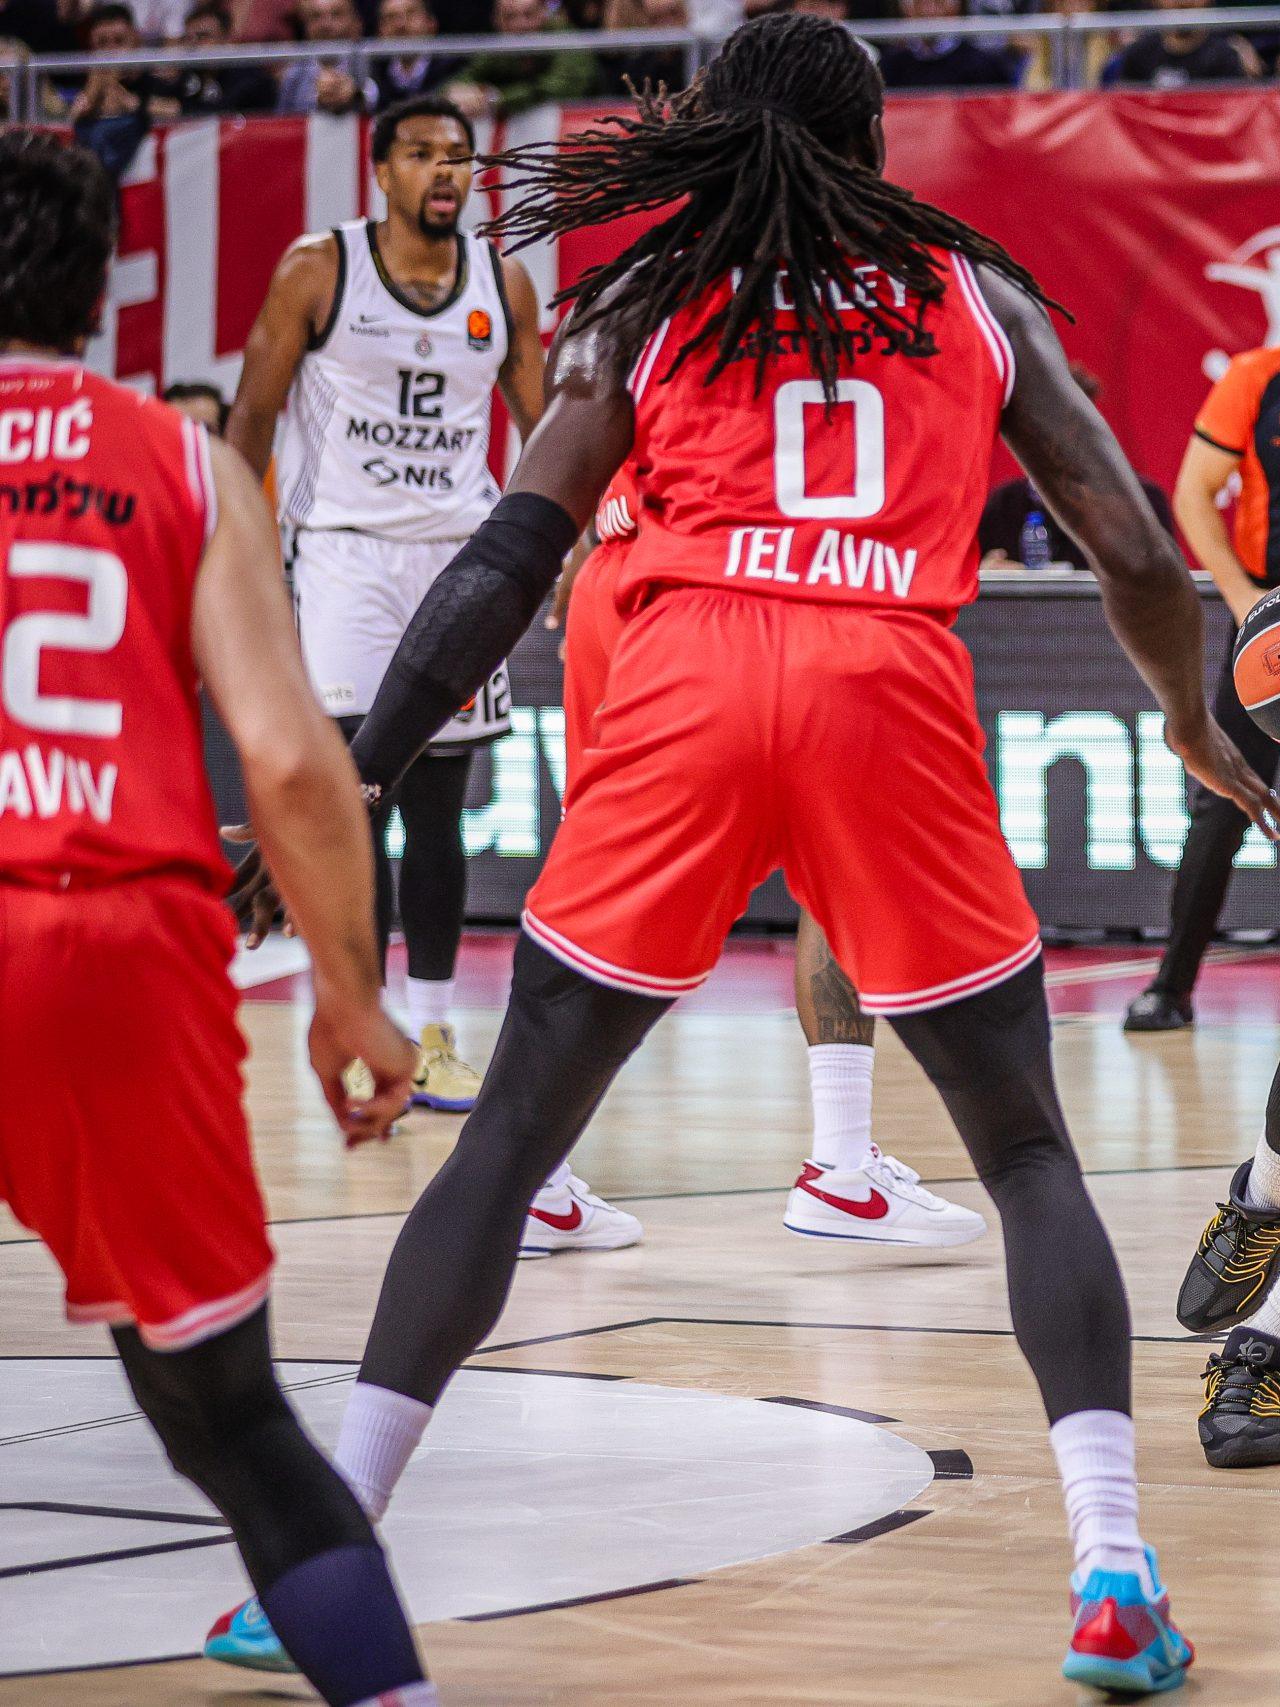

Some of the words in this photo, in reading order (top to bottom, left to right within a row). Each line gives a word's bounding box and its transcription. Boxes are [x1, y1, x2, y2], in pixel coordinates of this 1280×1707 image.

[398, 370, 446, 419] 12
[0, 396, 94, 465] CIĆ
[346, 417, 477, 451] MOZZART
[774, 379, 887, 520] 0
[405, 464, 455, 490] NIS
[724, 526, 800, 583] TEL
[805, 527, 918, 599] AVIV
[5, 541, 129, 739] 2
[0, 743, 119, 826] AVIV
